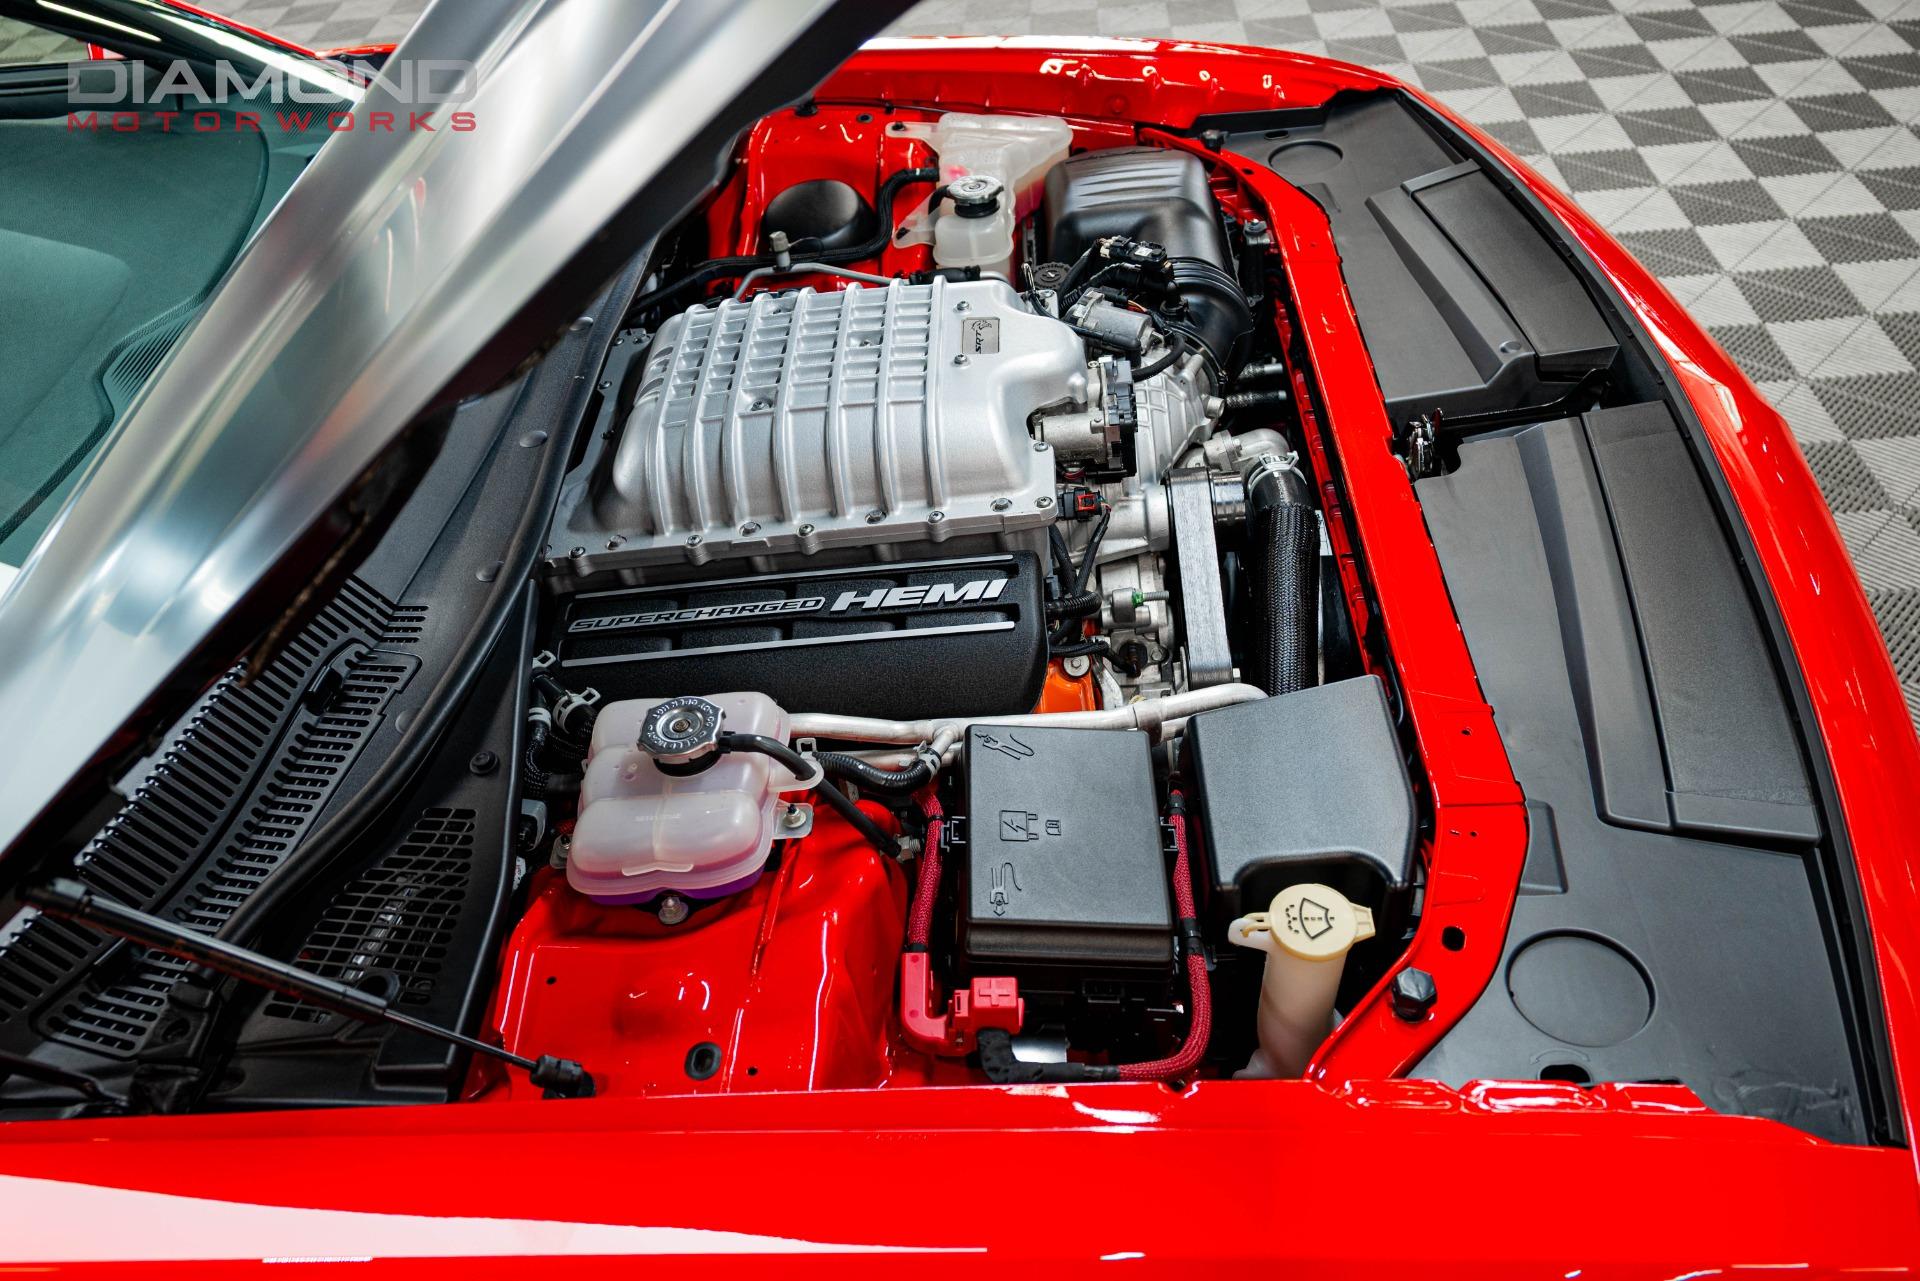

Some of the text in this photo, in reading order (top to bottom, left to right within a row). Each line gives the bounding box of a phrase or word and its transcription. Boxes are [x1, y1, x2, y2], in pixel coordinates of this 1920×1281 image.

[975, 329, 985, 354] SRT
[571, 579, 1008, 632] SUPERCHARGED HEMI
